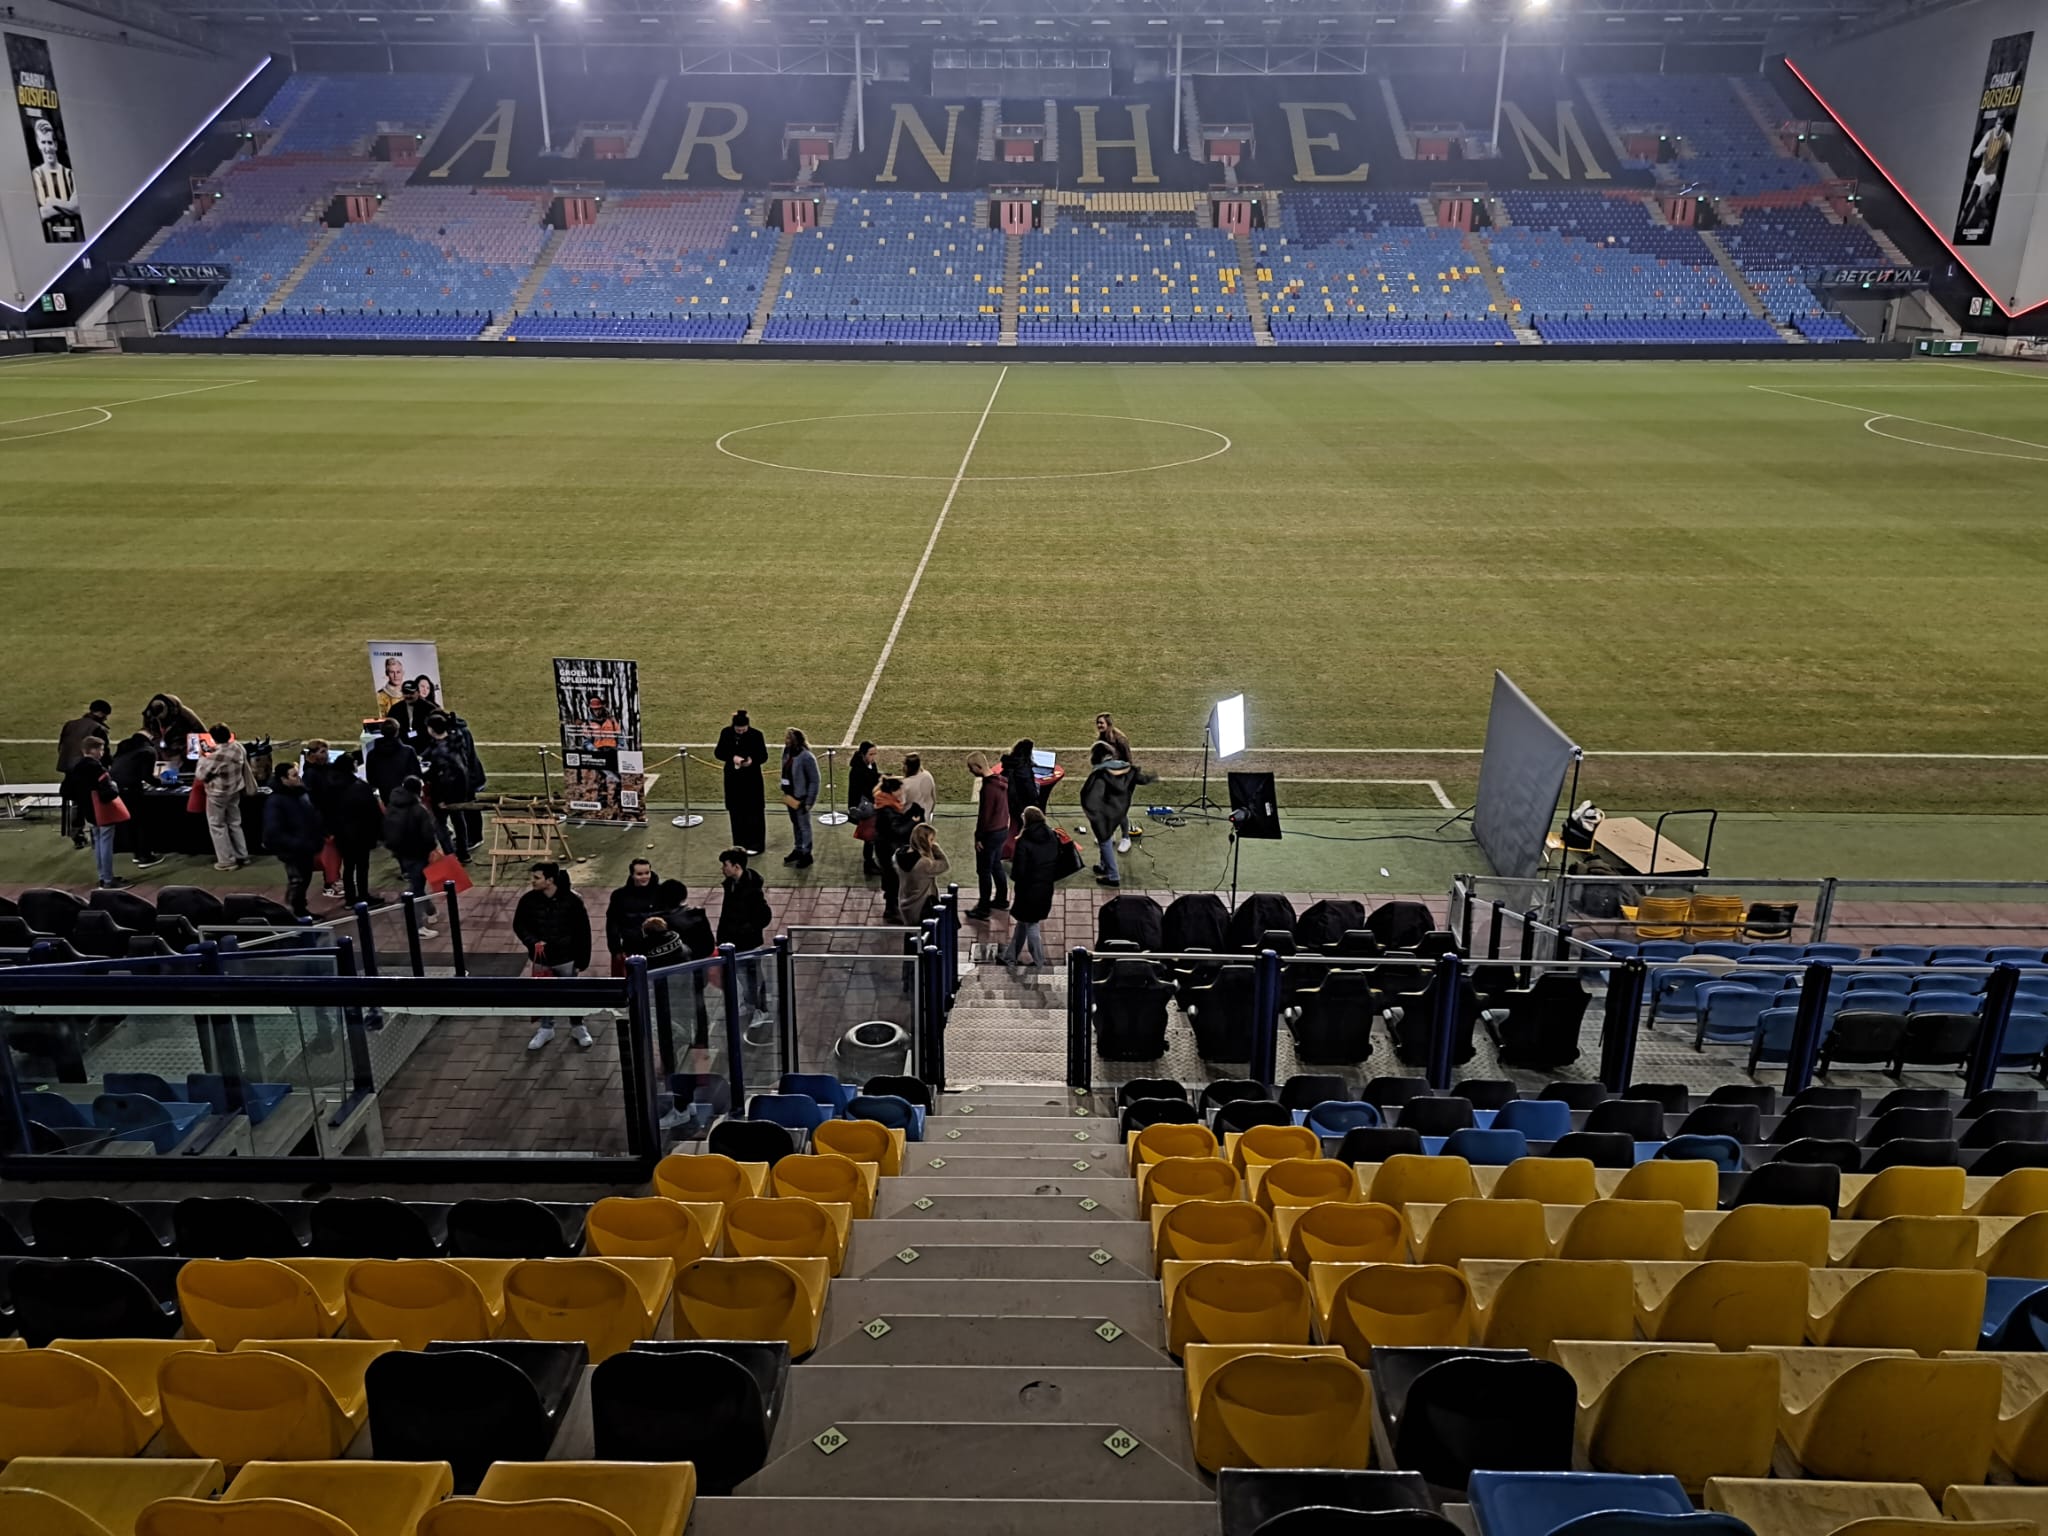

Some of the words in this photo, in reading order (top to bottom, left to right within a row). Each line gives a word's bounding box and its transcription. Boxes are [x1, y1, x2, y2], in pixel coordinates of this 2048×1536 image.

[18, 86, 58, 109] BOSVELD
[1981, 85, 2021, 109] BOSVELD
[429, 99, 1612, 184] ARNHEM
[559, 669, 588, 677] GROEN
[560, 676, 613, 685] OPLEIDINGEN
[869, 1324, 885, 1333] 07
[1101, 1328, 1117, 1336] 07
[819, 1435, 840, 1446] 08
[1111, 1437, 1130, 1449] 08
